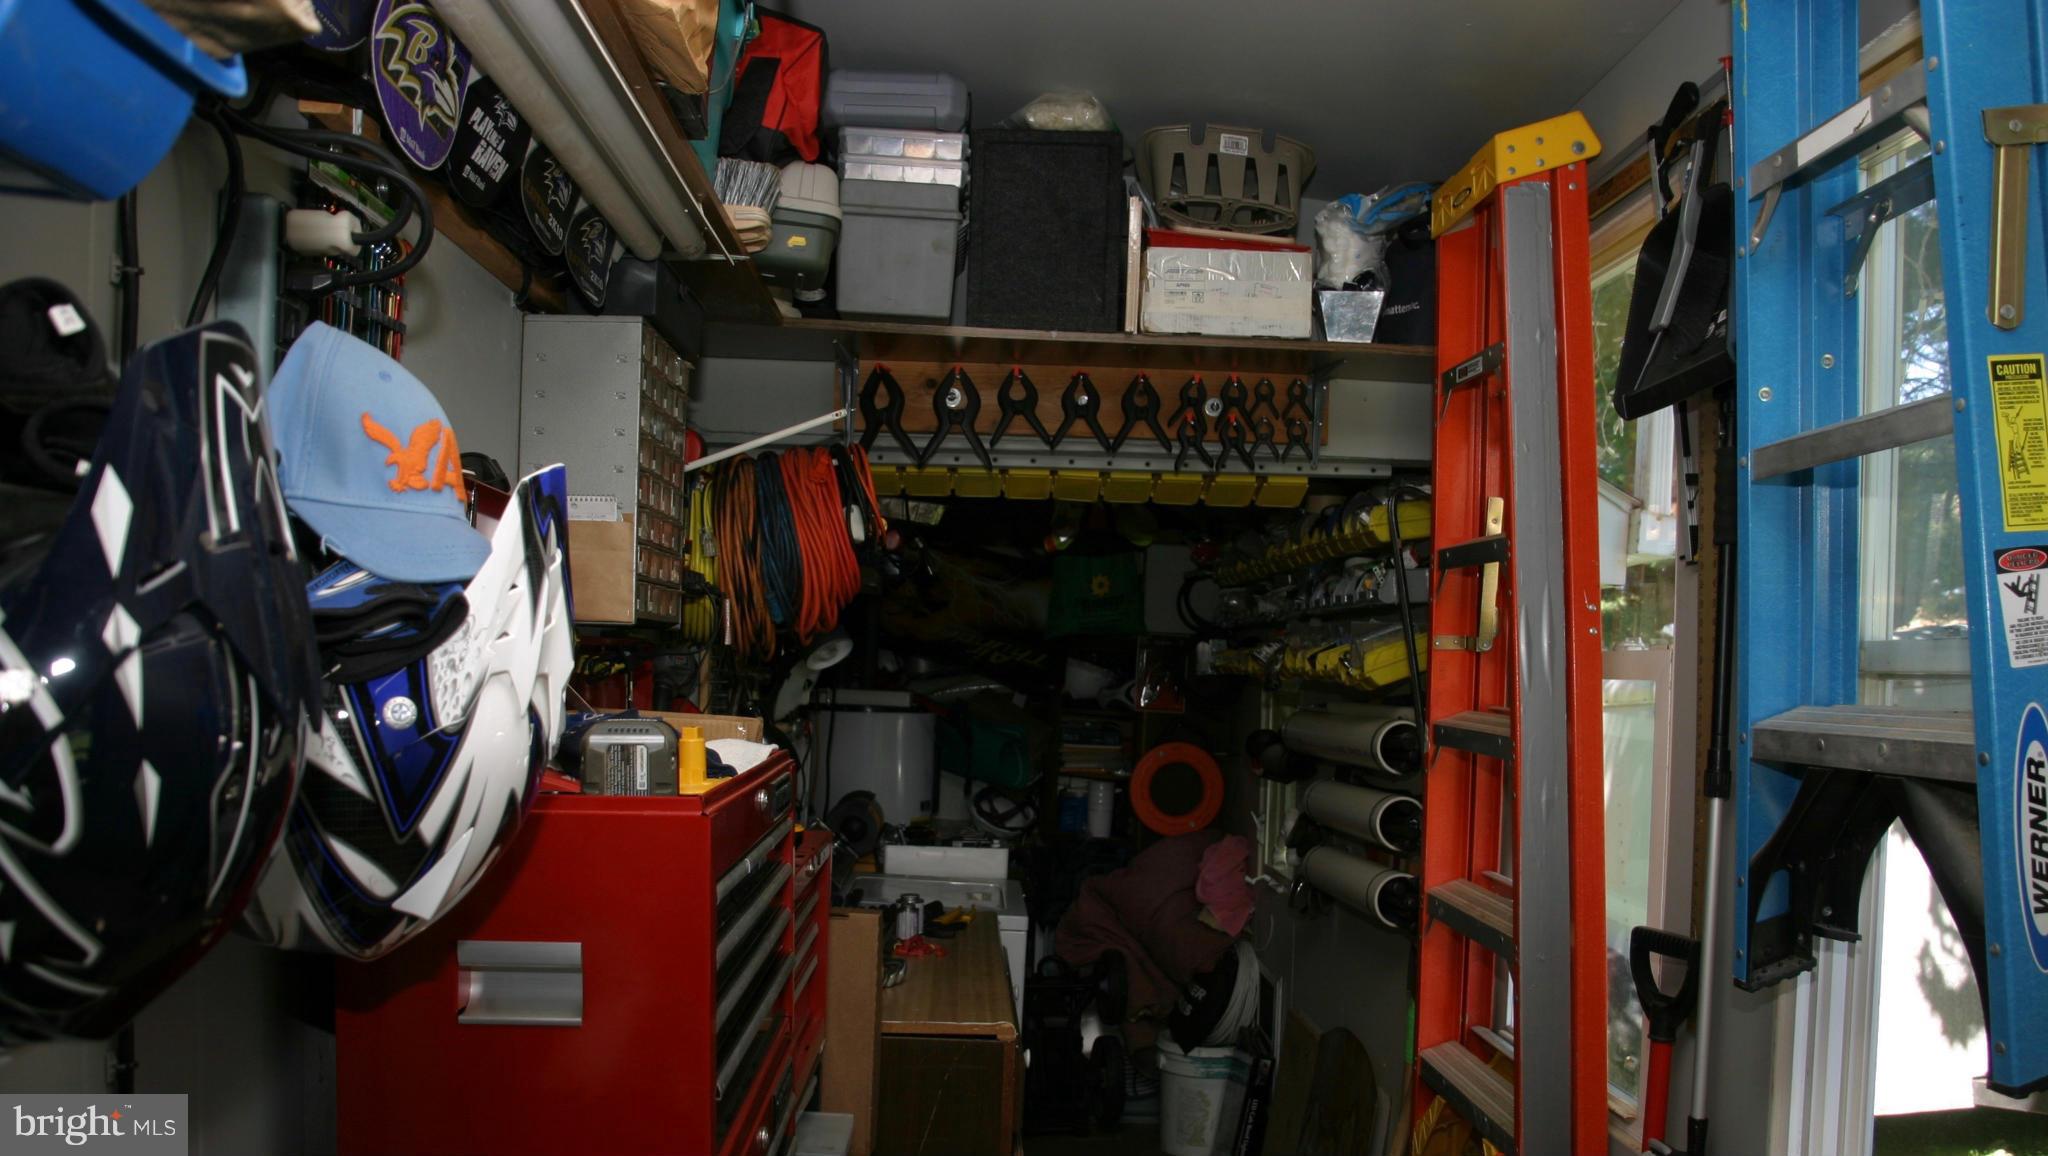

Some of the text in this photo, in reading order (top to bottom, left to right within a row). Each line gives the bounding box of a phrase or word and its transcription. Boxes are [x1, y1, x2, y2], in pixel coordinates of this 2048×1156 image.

[468, 107, 495, 138] PLAY
[470, 139, 509, 182] RAVEN
[1996, 363, 2037, 376] CAUTION
[2026, 756, 2048, 915] WERNER
